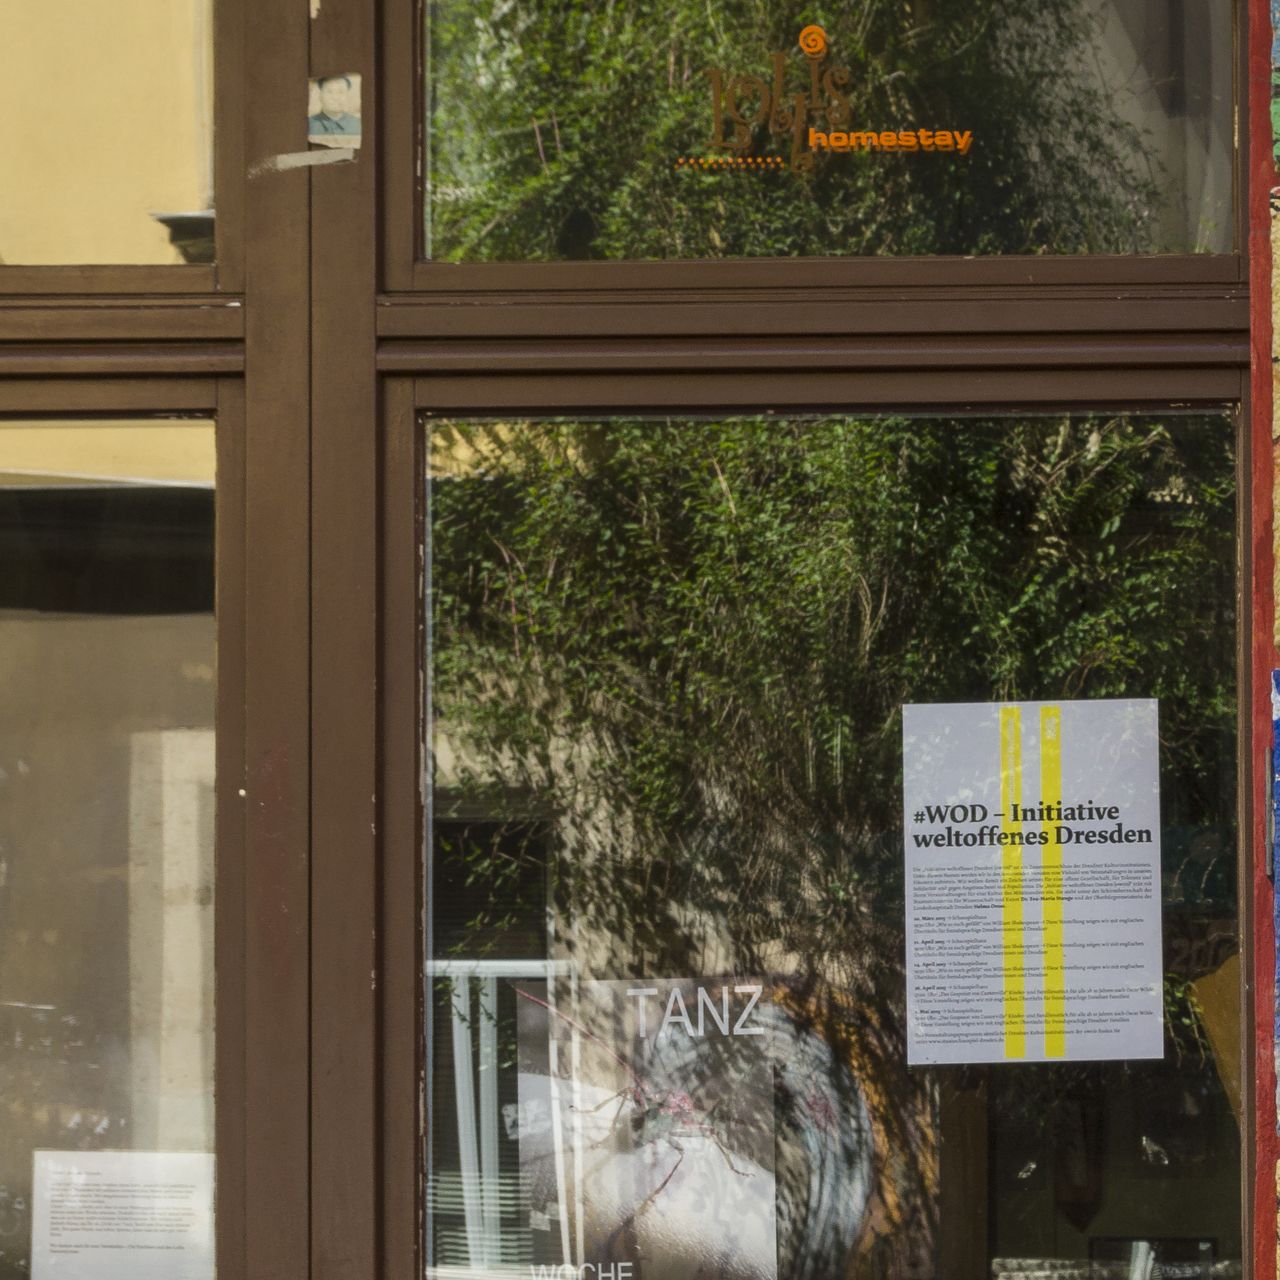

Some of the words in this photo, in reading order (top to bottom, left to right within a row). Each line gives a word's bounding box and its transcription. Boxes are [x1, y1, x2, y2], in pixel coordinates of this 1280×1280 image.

[808, 128, 972, 154] homestay
[913, 803, 988, 825] #WOD
[1011, 799, 1120, 822] Initiative
[913, 825, 1048, 848] weltoffenes
[1055, 822, 1153, 845] Dresden
[626, 984, 765, 1038] TANZ
